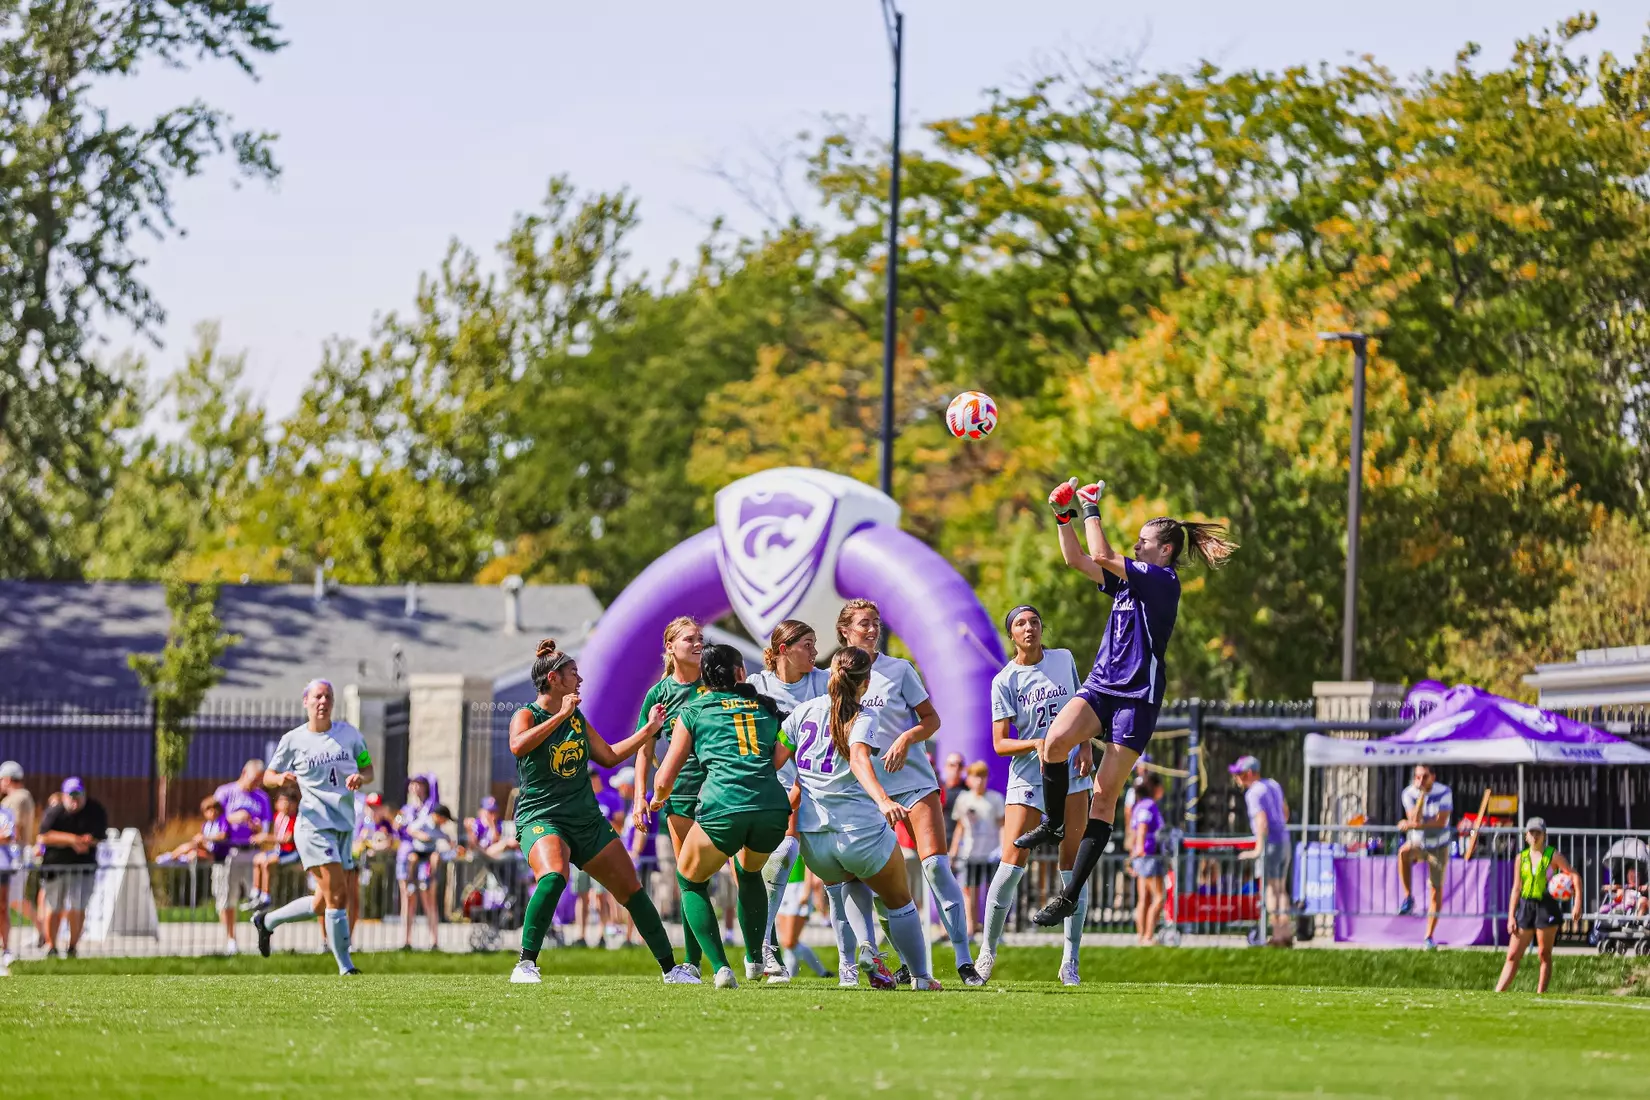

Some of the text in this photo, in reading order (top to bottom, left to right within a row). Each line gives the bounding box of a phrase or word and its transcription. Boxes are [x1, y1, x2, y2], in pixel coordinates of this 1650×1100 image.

[861, 695, 884, 708] cats
[1018, 685, 1068, 707] Wildcats
[1036, 702, 1059, 729] 25
[734, 714, 761, 756] 11
[796, 719, 835, 774] 27
[307, 750, 349, 769] Wildcats
[328, 766, 338, 787] 4
